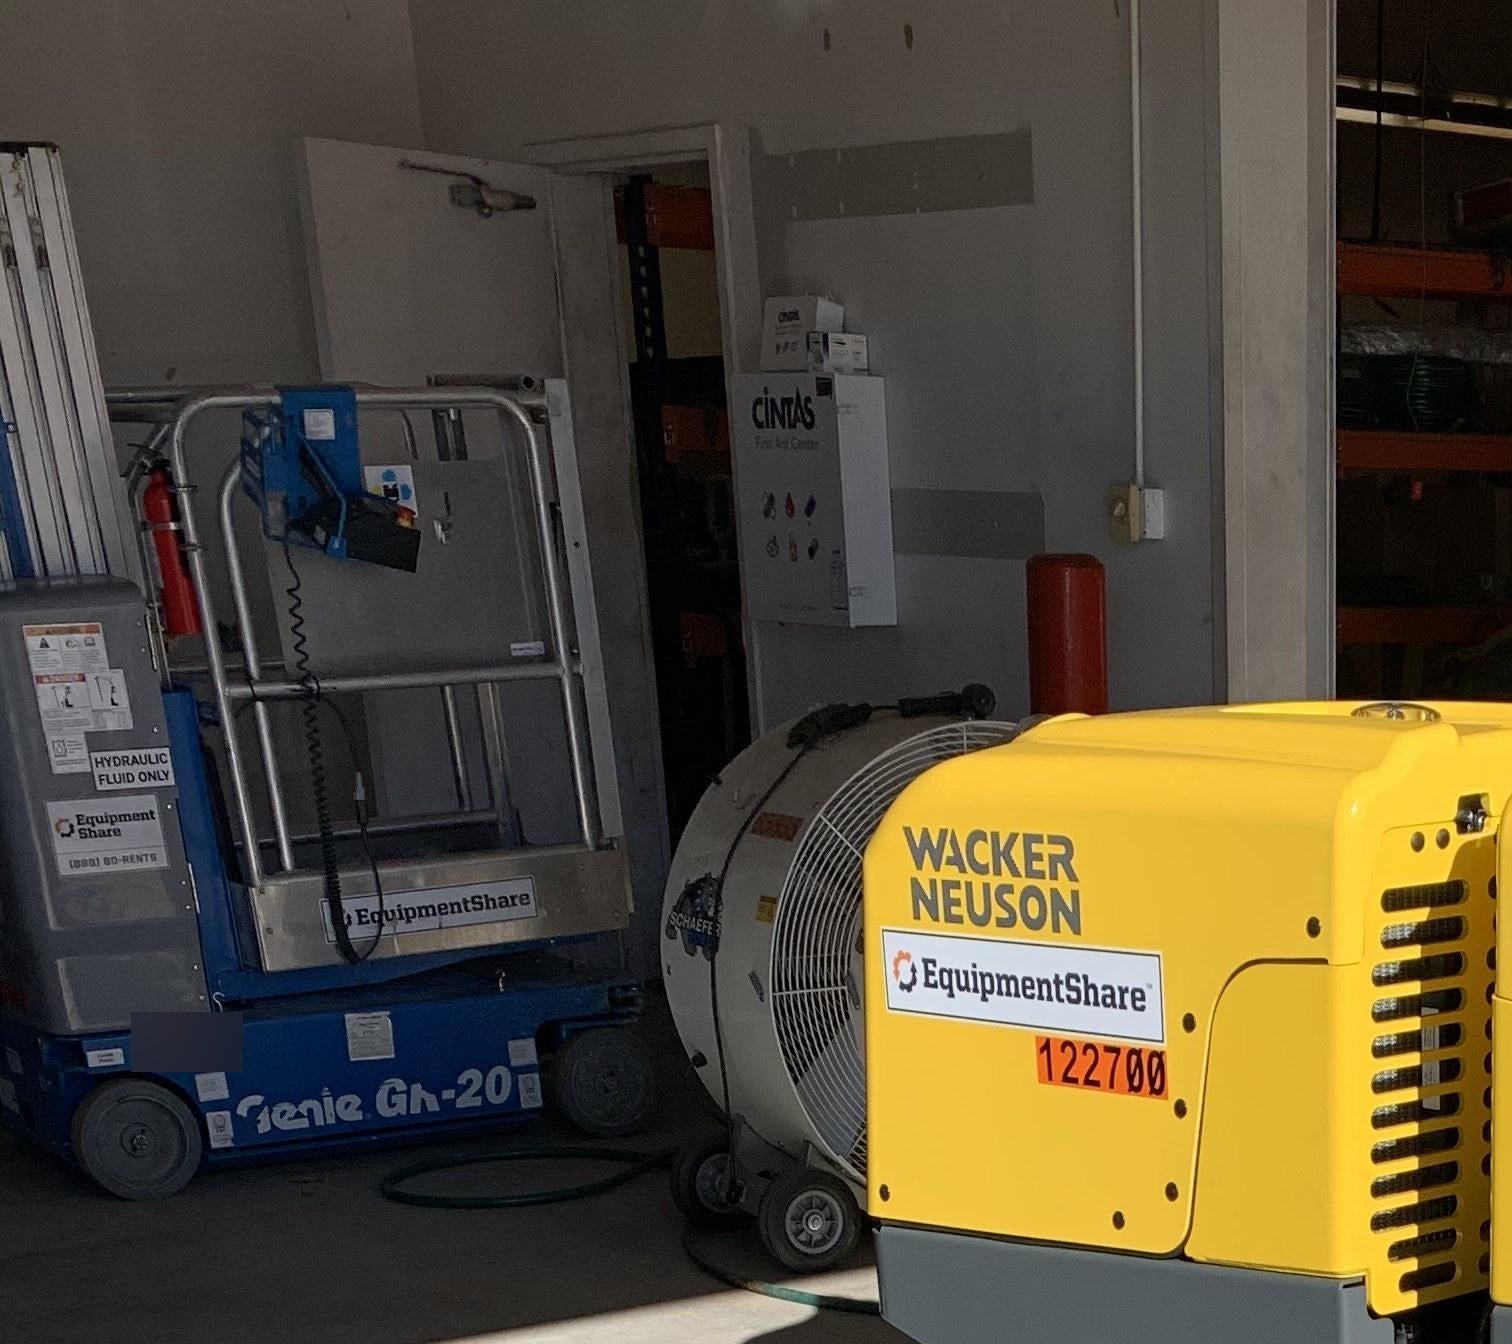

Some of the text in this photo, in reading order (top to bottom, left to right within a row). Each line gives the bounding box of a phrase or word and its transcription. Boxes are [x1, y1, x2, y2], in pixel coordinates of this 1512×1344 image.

[94, 752, 168, 769] HYDRAULIC
[98, 769, 169, 785] FLUID ONLY
[76, 810, 156, 828] Equipment
[78, 826, 122, 839] Share
[902, 825, 1079, 883] WACKER
[355, 892, 531, 927] EquipmentShare
[909, 876, 1082, 936] NEUSON
[921, 956, 1147, 1012] EquipmentShare
[1039, 1036, 1166, 1096] 122700
